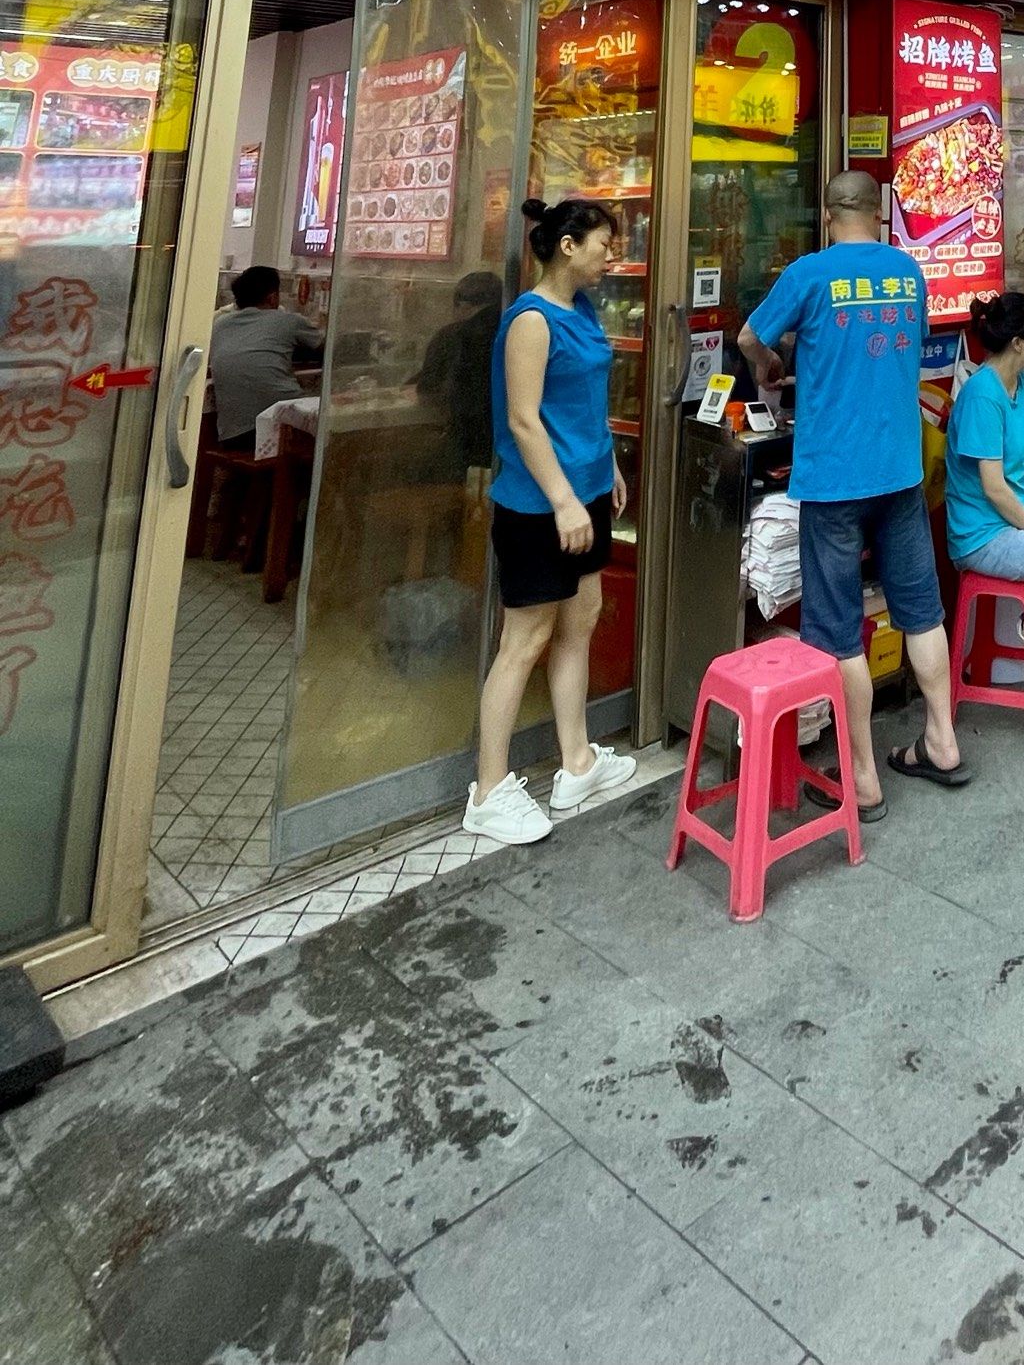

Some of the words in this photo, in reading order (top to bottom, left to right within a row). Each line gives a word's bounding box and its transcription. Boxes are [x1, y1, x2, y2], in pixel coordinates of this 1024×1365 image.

[559, 30, 637, 65] 统一企业
[898, 31, 998, 74] 招牌烤鱼
